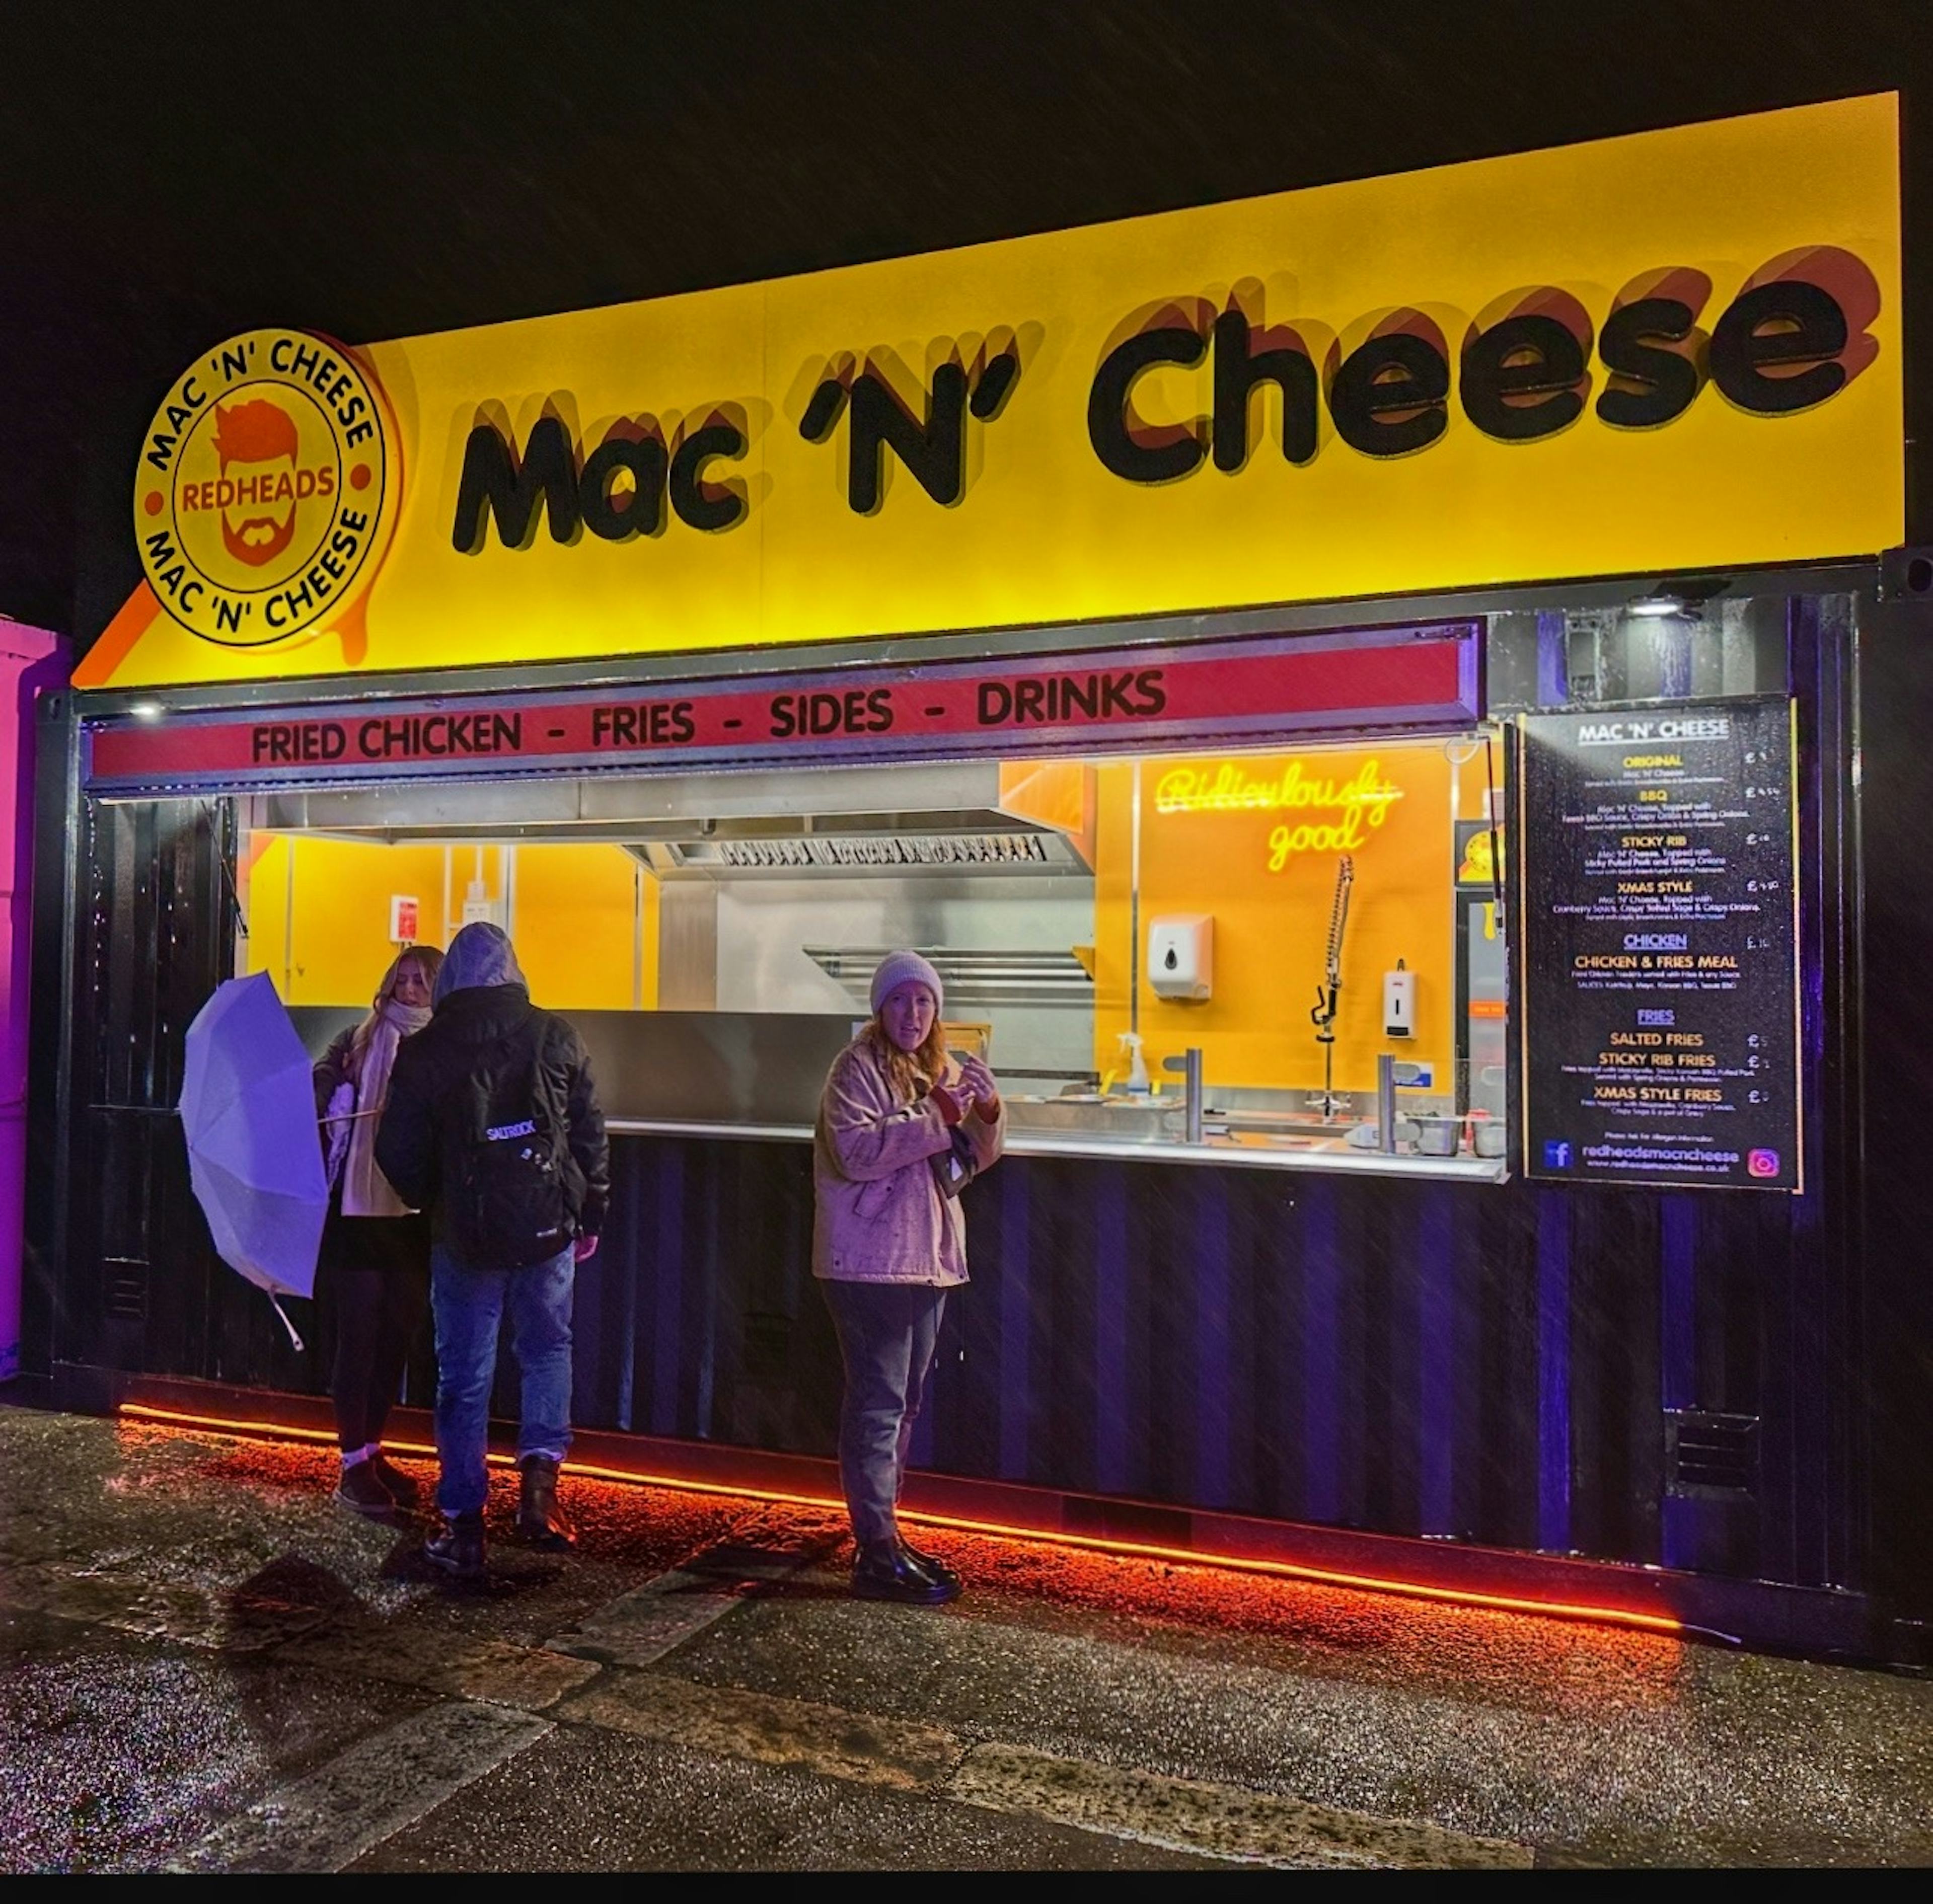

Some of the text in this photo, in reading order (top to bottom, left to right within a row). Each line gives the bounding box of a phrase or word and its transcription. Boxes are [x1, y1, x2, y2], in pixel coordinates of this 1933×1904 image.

[147, 339, 374, 471] MAC 'N' CHEESE
[452, 280, 1849, 555] Mac 'N' Cheese
[183, 466, 335, 512] REDHEADS
[146, 508, 367, 633] MAC 'N' CHEESE
[252, 721, 346, 763] FRIED
[358, 712, 522, 758] CHICKEN
[591, 702, 695, 746] FRIES
[770, 688, 894, 738] SIDES
[977, 670, 1166, 725] DRINKS
[1579, 718, 1730, 741] MAC 'N' CHEESE
[1622, 754, 1684, 769] ORIGINAL
[1156, 758, 1393, 827] Ridiculously
[1640, 789, 1668, 802] BBQ
[1268, 805, 1365, 871] good
[1621, 834, 1687, 848] STICKY RIB
[1617, 880, 1693, 893] XMAS STYLE
[1623, 934, 1687, 949] CHICKEN
[1574, 956, 1738, 968] CHICKEN & FRIES MEAL
[1637, 1008, 1675, 1024] FRIES
[1610, 1032, 1704, 1047] SALTED FRIES
[1598, 1051, 1716, 1067] STICKY RIB FRIES
[1594, 1086, 1723, 1102] XMAS STYLE FRIES
[1582, 1144, 1740, 1163] redheadsmacncheese
